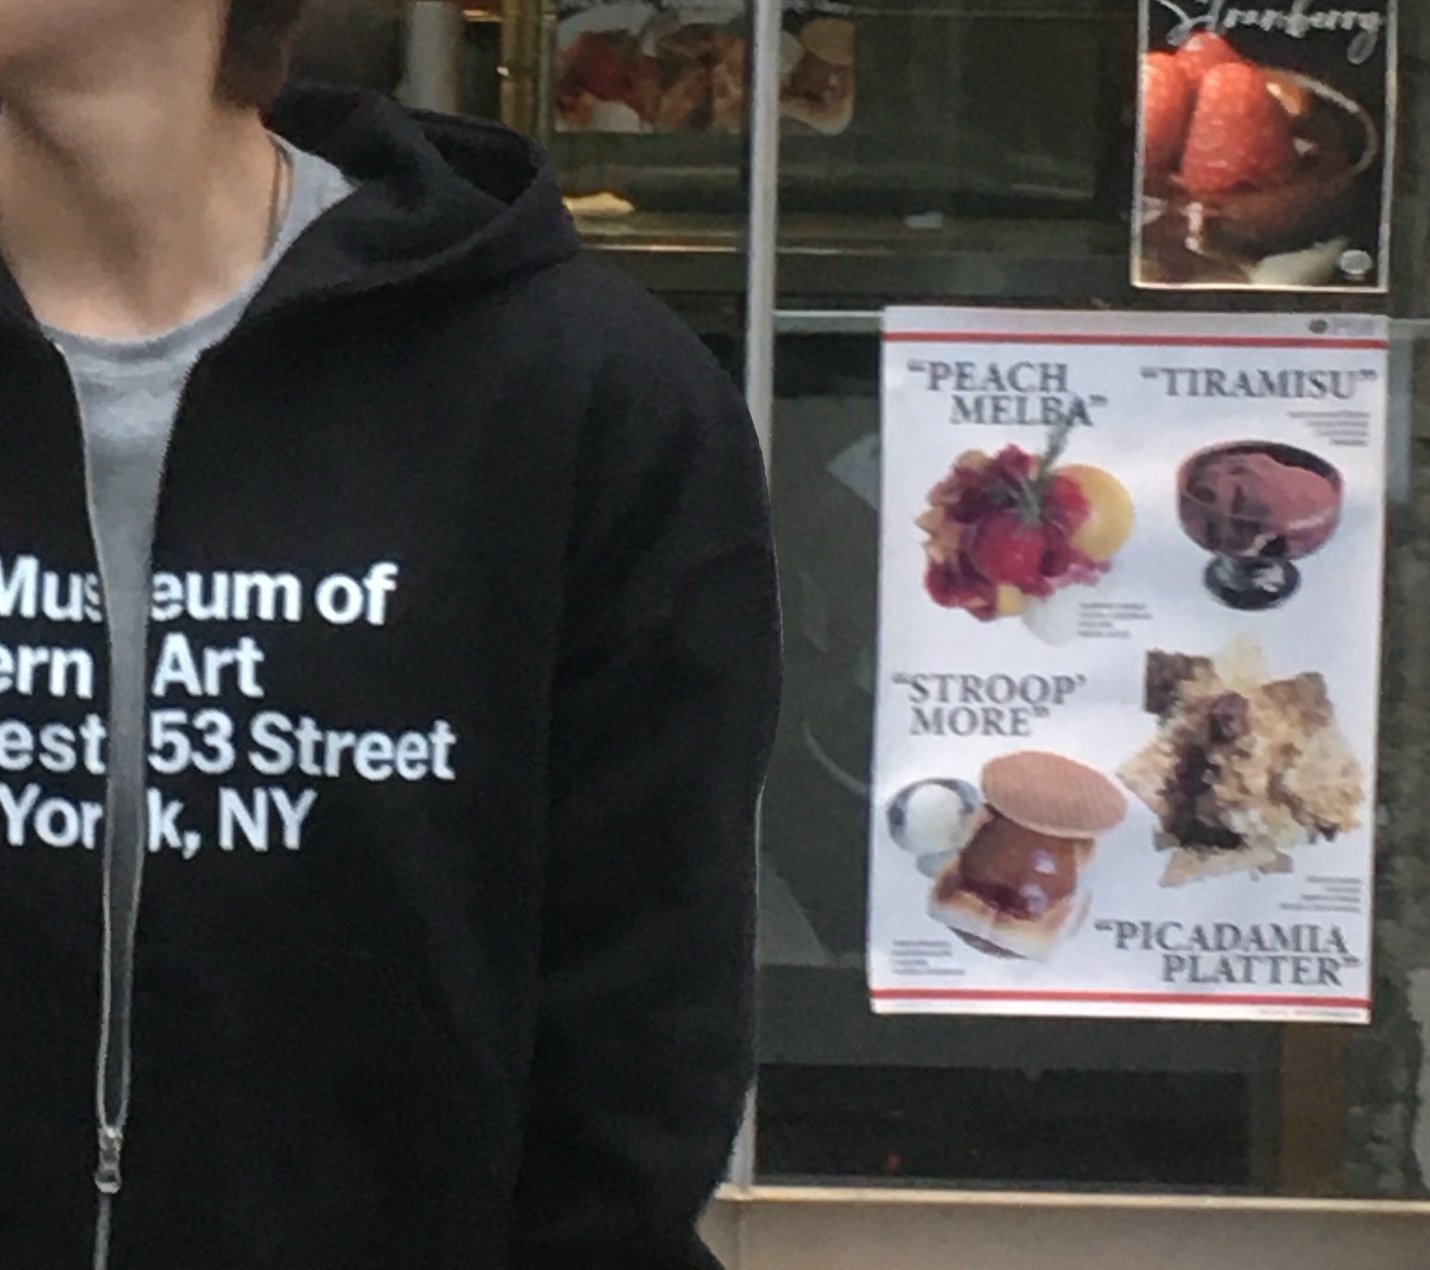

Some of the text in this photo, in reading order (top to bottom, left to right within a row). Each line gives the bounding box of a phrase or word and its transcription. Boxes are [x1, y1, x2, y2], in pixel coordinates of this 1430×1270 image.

[315, 561, 399, 626] of
[150, 631, 265, 699] Art
[147, 708, 237, 775] 53
[248, 710, 457, 781] Street
[218, 787, 318, 853] NY
